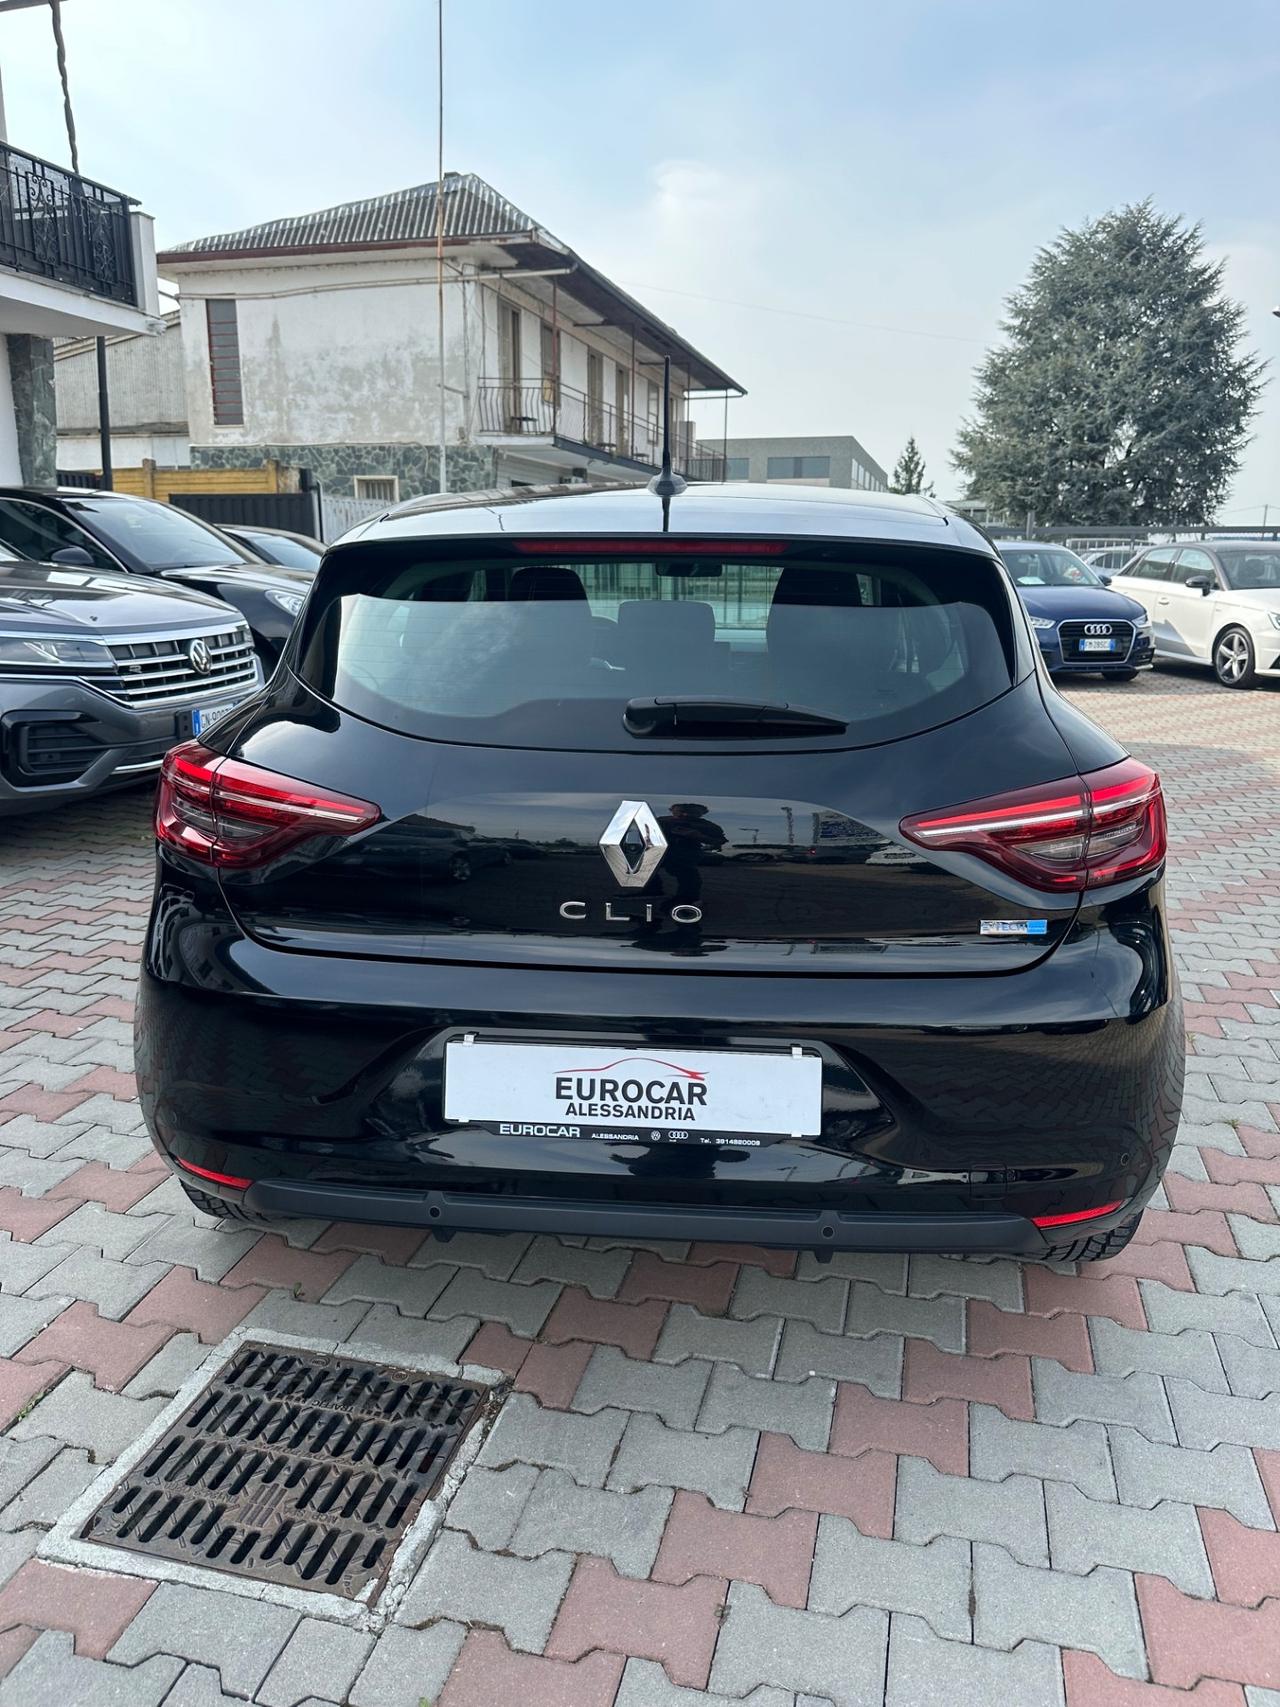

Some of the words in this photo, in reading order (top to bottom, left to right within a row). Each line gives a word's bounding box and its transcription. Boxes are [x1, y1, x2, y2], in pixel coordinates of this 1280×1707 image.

[559, 901, 703, 923] CLIO
[555, 1076, 707, 1106] EUROCAR
[565, 1103, 696, 1121] ALESSANDRIA
[499, 1123, 580, 1138] EUROCAR
[591, 1132, 639, 1141] ALESSANDRIA
